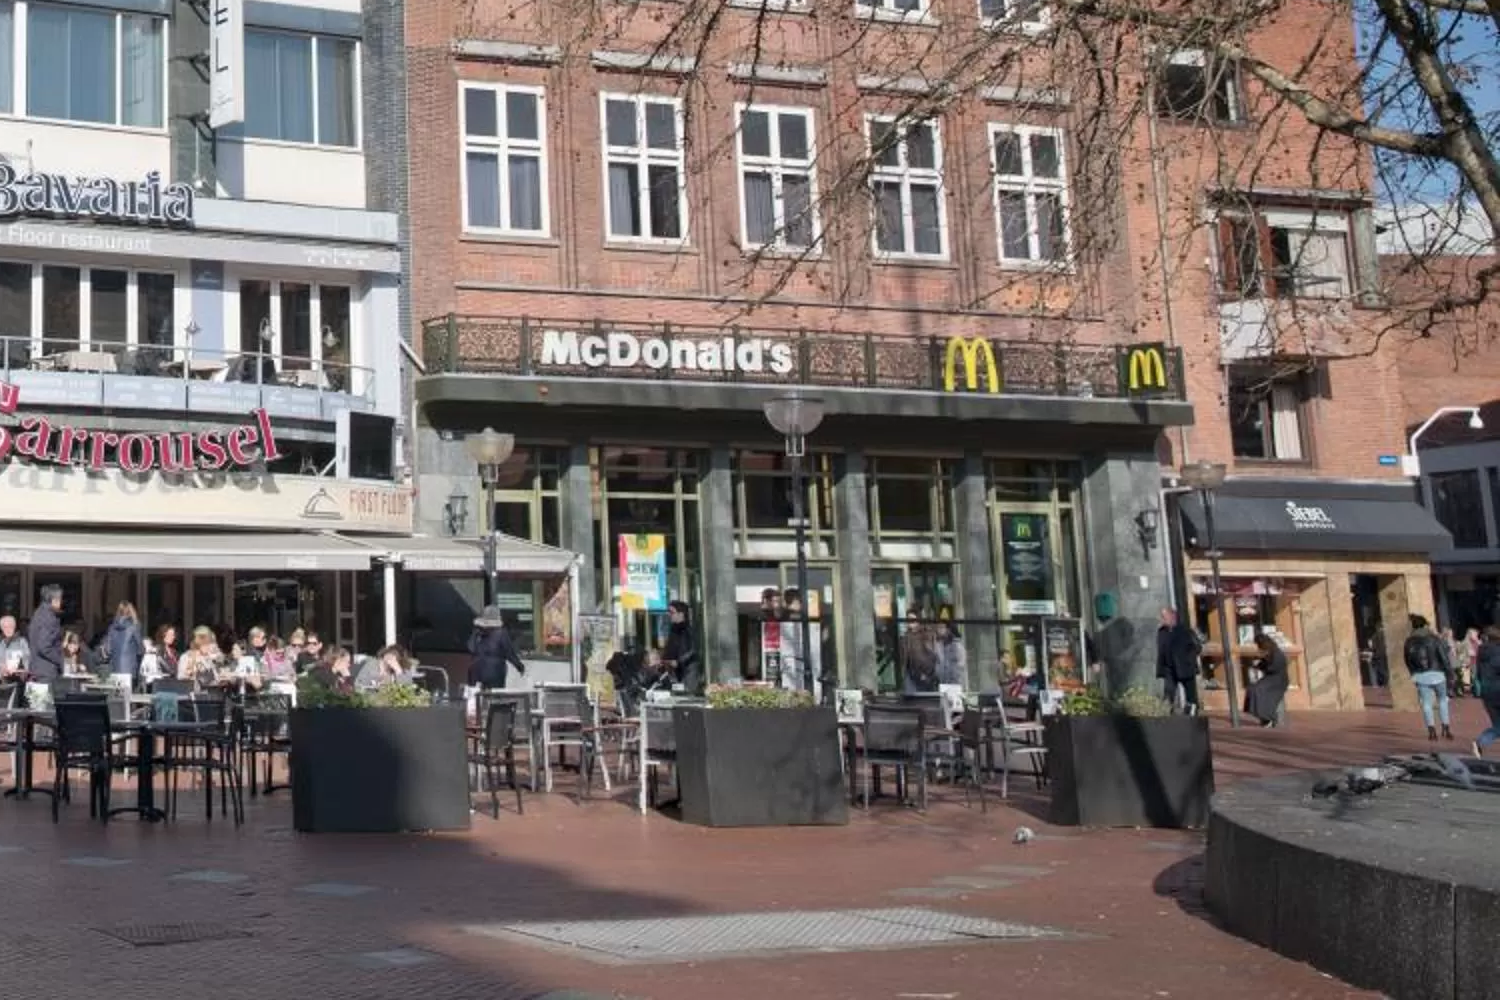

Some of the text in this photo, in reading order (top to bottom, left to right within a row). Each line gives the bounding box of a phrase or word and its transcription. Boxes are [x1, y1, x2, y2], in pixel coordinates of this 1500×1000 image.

[7, 224, 56, 246] Floor
[60, 230, 152, 252] restaurant
[541, 331, 794, 374] McDonald's
